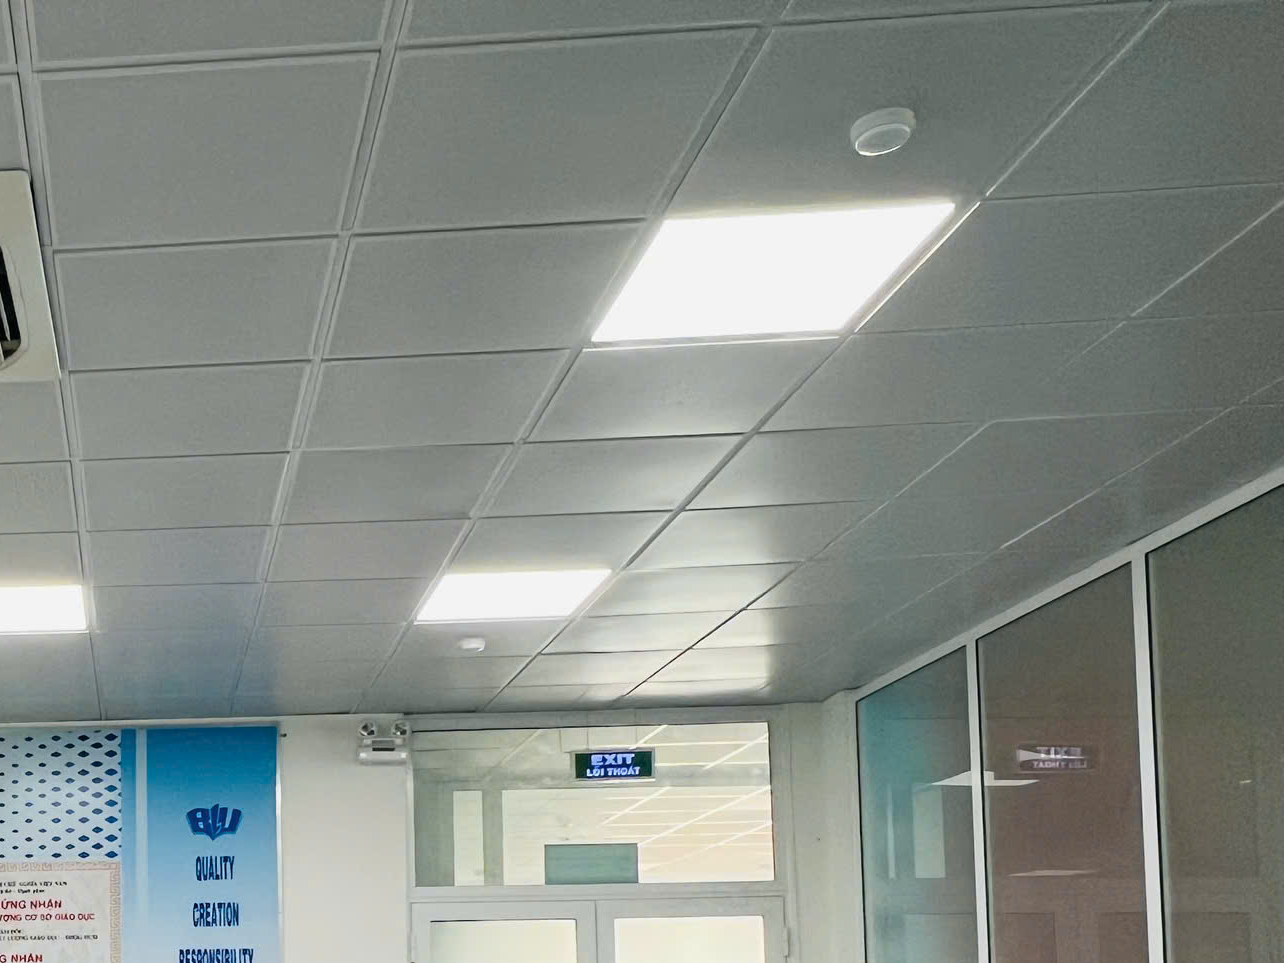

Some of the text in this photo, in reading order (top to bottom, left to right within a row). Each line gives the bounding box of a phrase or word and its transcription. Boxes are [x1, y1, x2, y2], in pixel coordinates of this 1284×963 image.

[591, 753, 635, 766] EXIT
[586, 765, 640, 777] LỐI THOÁT
[195, 856, 235, 881] QUALITY
[193, 902, 239, 927] CREATION
